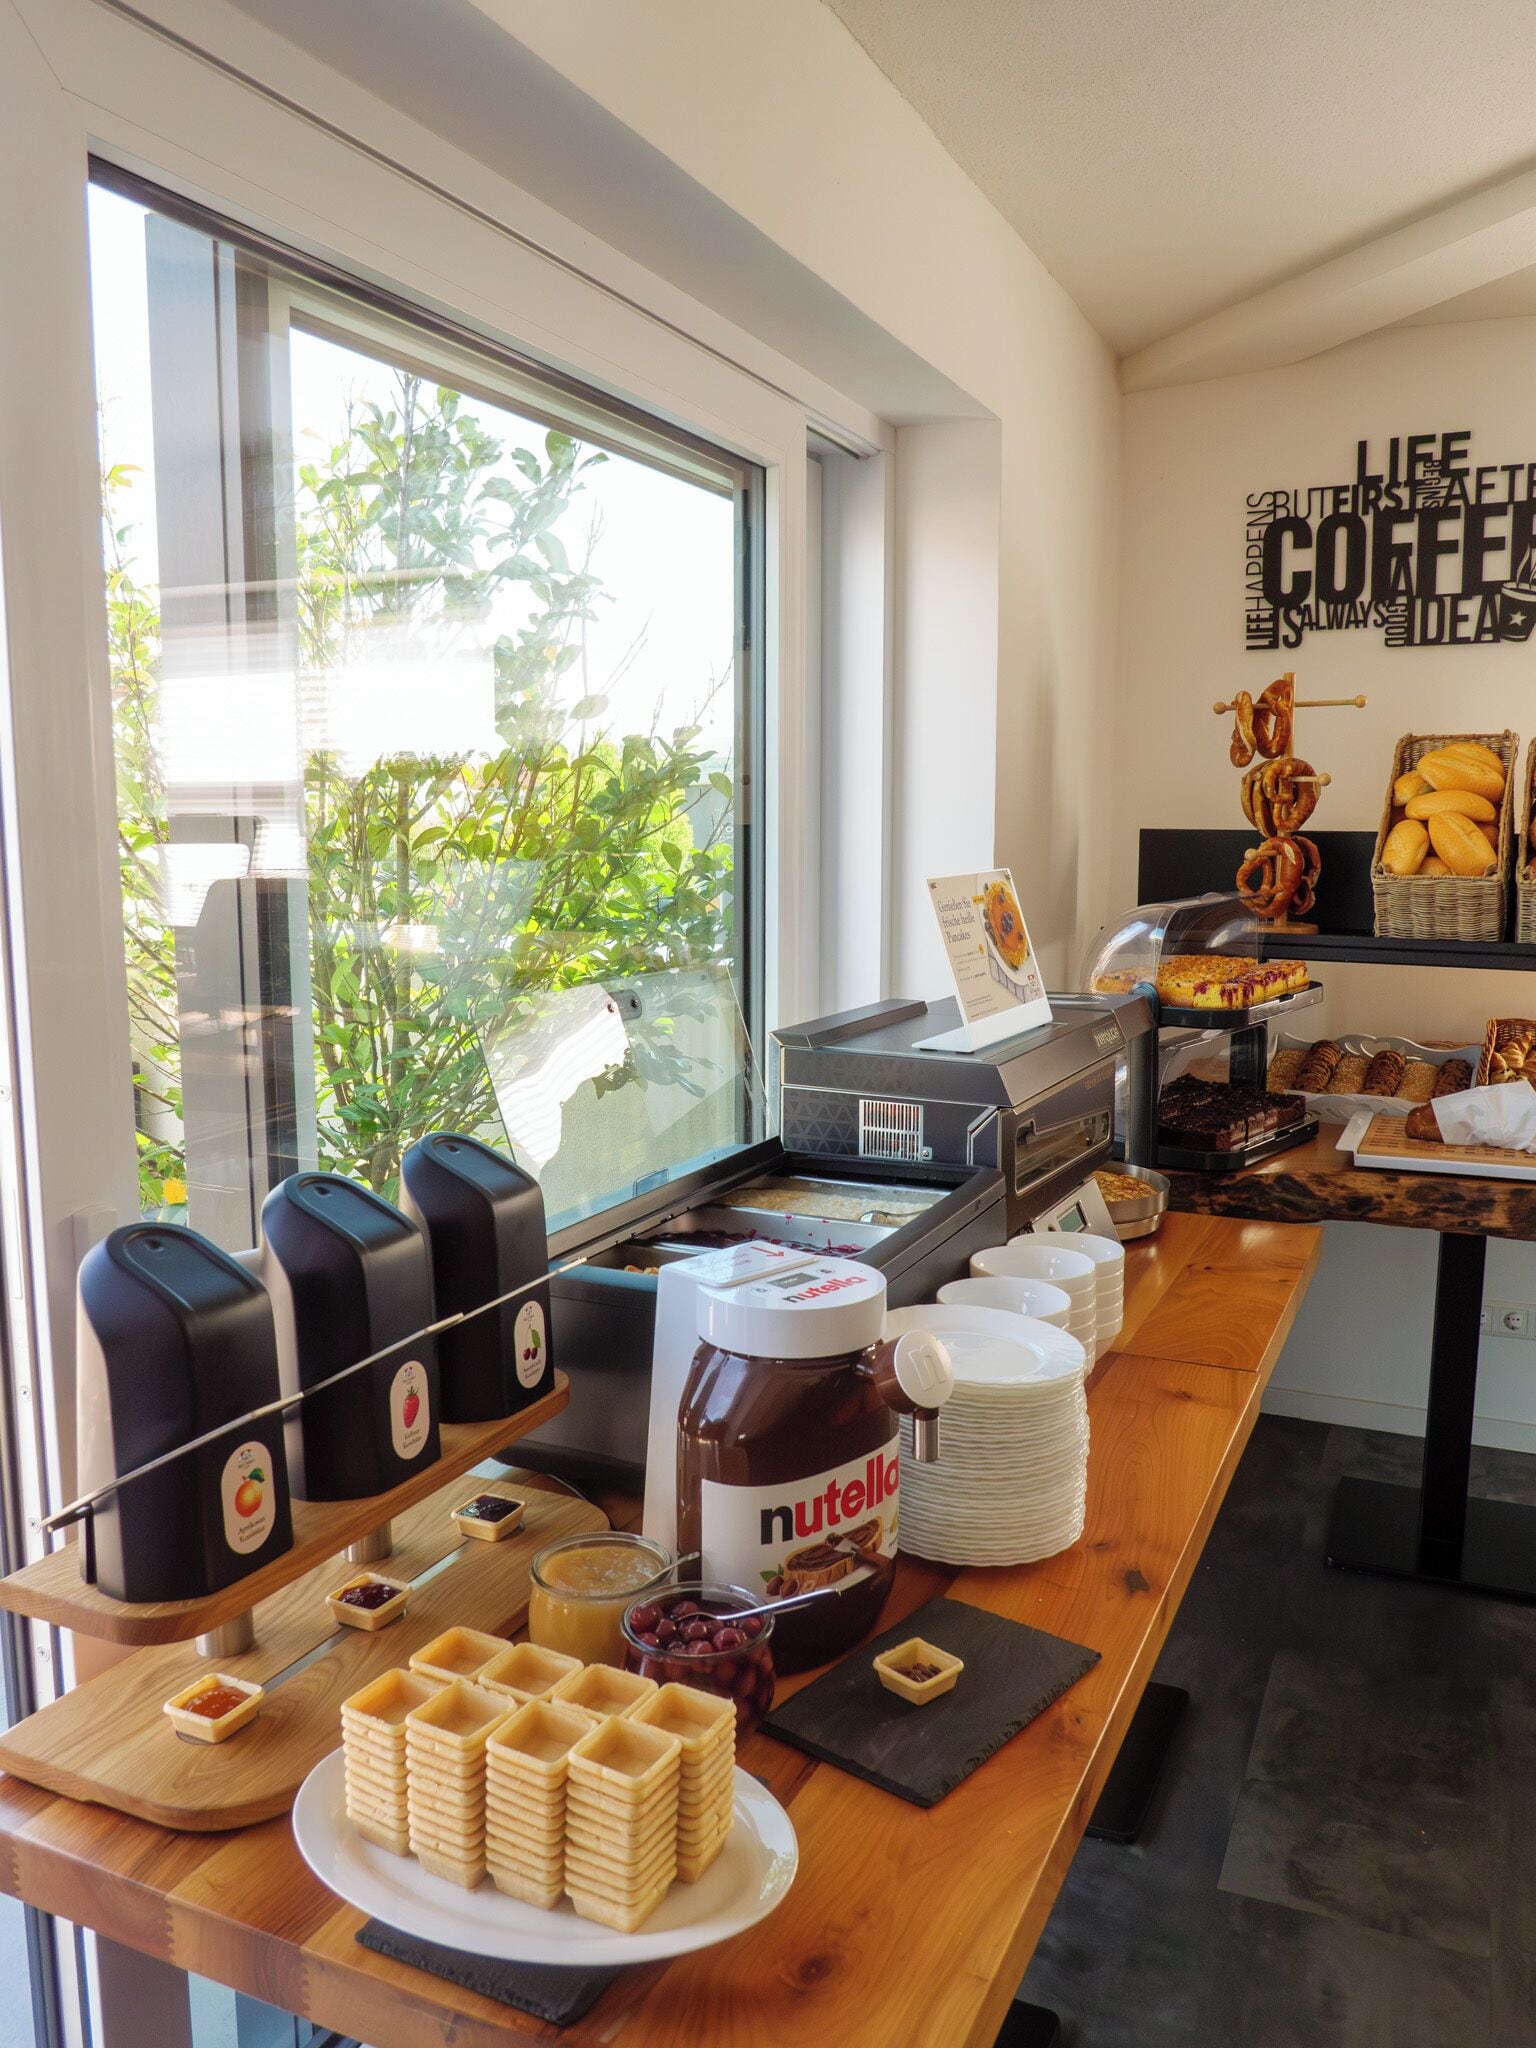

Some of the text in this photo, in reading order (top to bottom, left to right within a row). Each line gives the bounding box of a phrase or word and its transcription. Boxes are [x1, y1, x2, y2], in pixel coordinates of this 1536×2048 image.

[1357, 431, 1471, 486] LIFE
[1421, 458, 1447, 509] BEGINS
[1274, 486, 1335, 519] BUT
[1332, 479, 1426, 516] FIRST
[1245, 491, 1275, 650] LIFE HAPPENS
[1272, 554, 1501, 649] IS ALWAYS A GOOD IDEA
[782, 1276, 866, 1303] nutella
[760, 1454, 899, 1545] nutella
